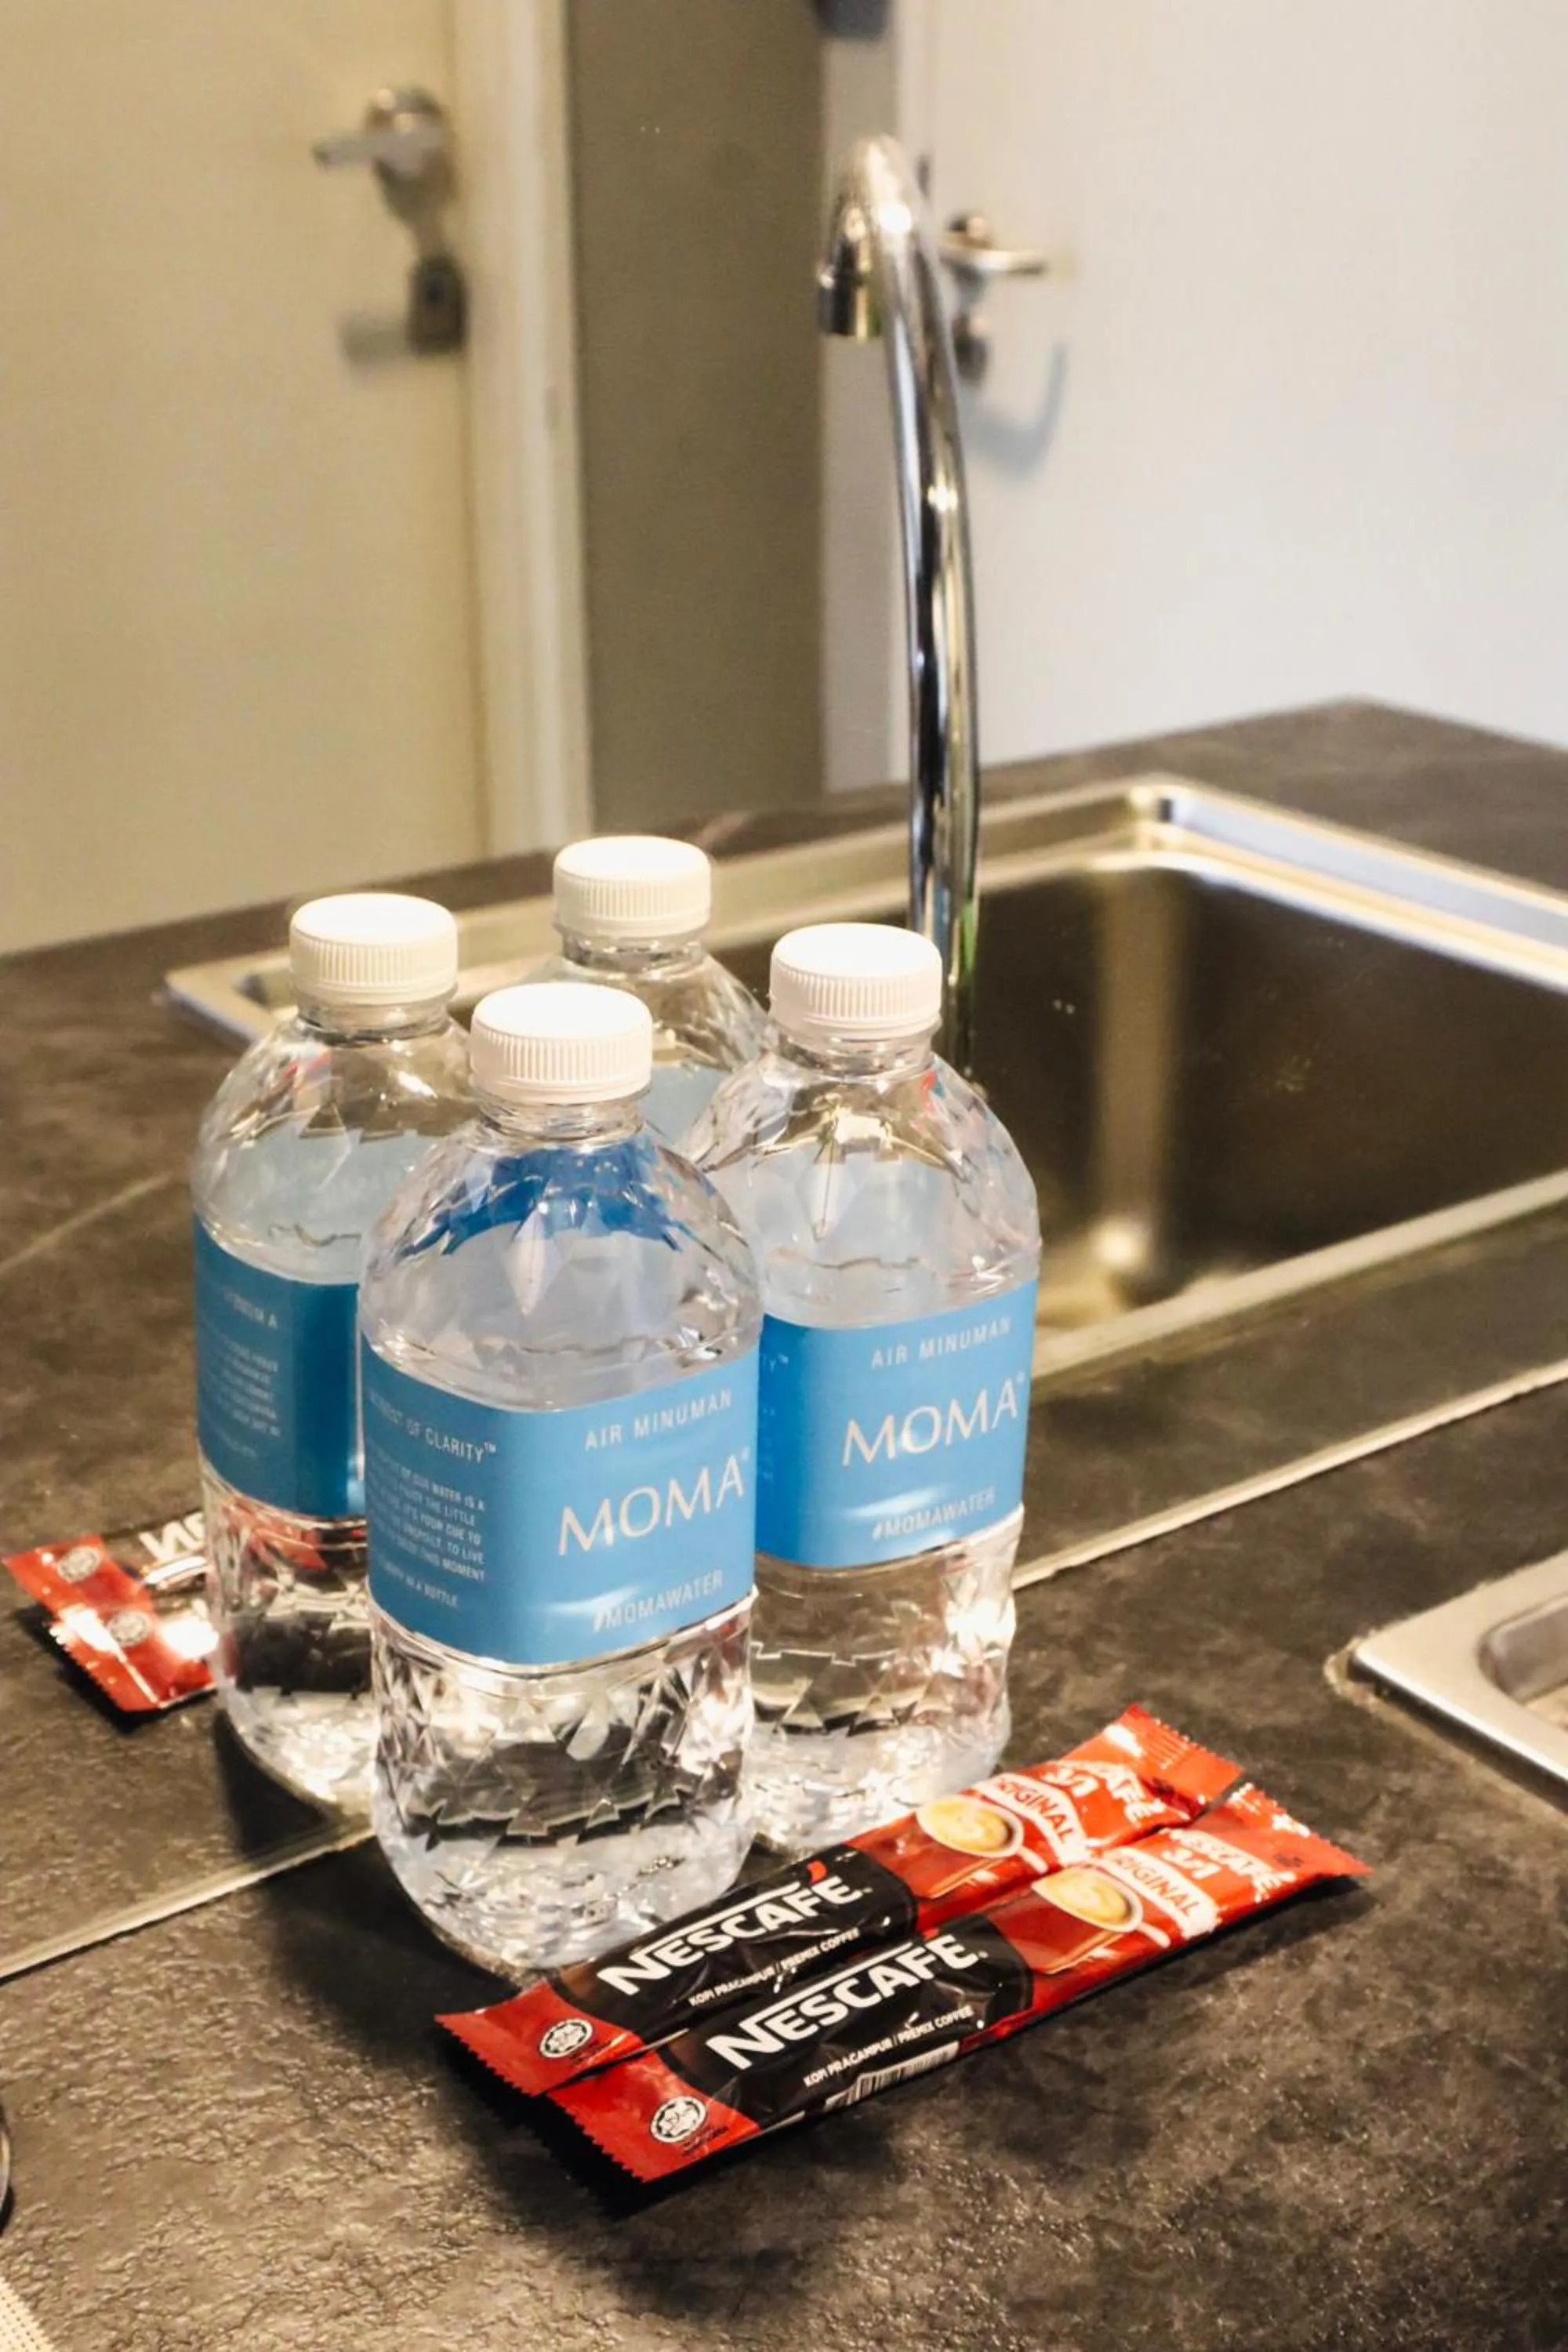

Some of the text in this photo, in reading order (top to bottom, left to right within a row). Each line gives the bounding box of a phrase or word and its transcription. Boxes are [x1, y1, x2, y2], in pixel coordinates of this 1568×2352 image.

[870, 1315, 1012, 1370] AIR MINUMAN
[584, 1389, 732, 1452] AIR MINUMAN
[841, 1377, 1018, 1467] MOMA
[432, 1482, 462, 1504] WATER
[444, 1504, 475, 1527] LITTLE
[558, 1453, 746, 1556] MOMA
[872, 1485, 996, 1541] #MOMAWATER
[447, 1541, 459, 1556] TO
[467, 1530, 481, 1547] TO
[442, 1557, 485, 1582] MOMENT
[593, 1569, 723, 1632] #MOMAWATER
[819, 1926, 861, 1953] COFFEE
[827, 2037, 894, 2077] PRACAMPUR
[934, 2004, 975, 2029] COFFEE
